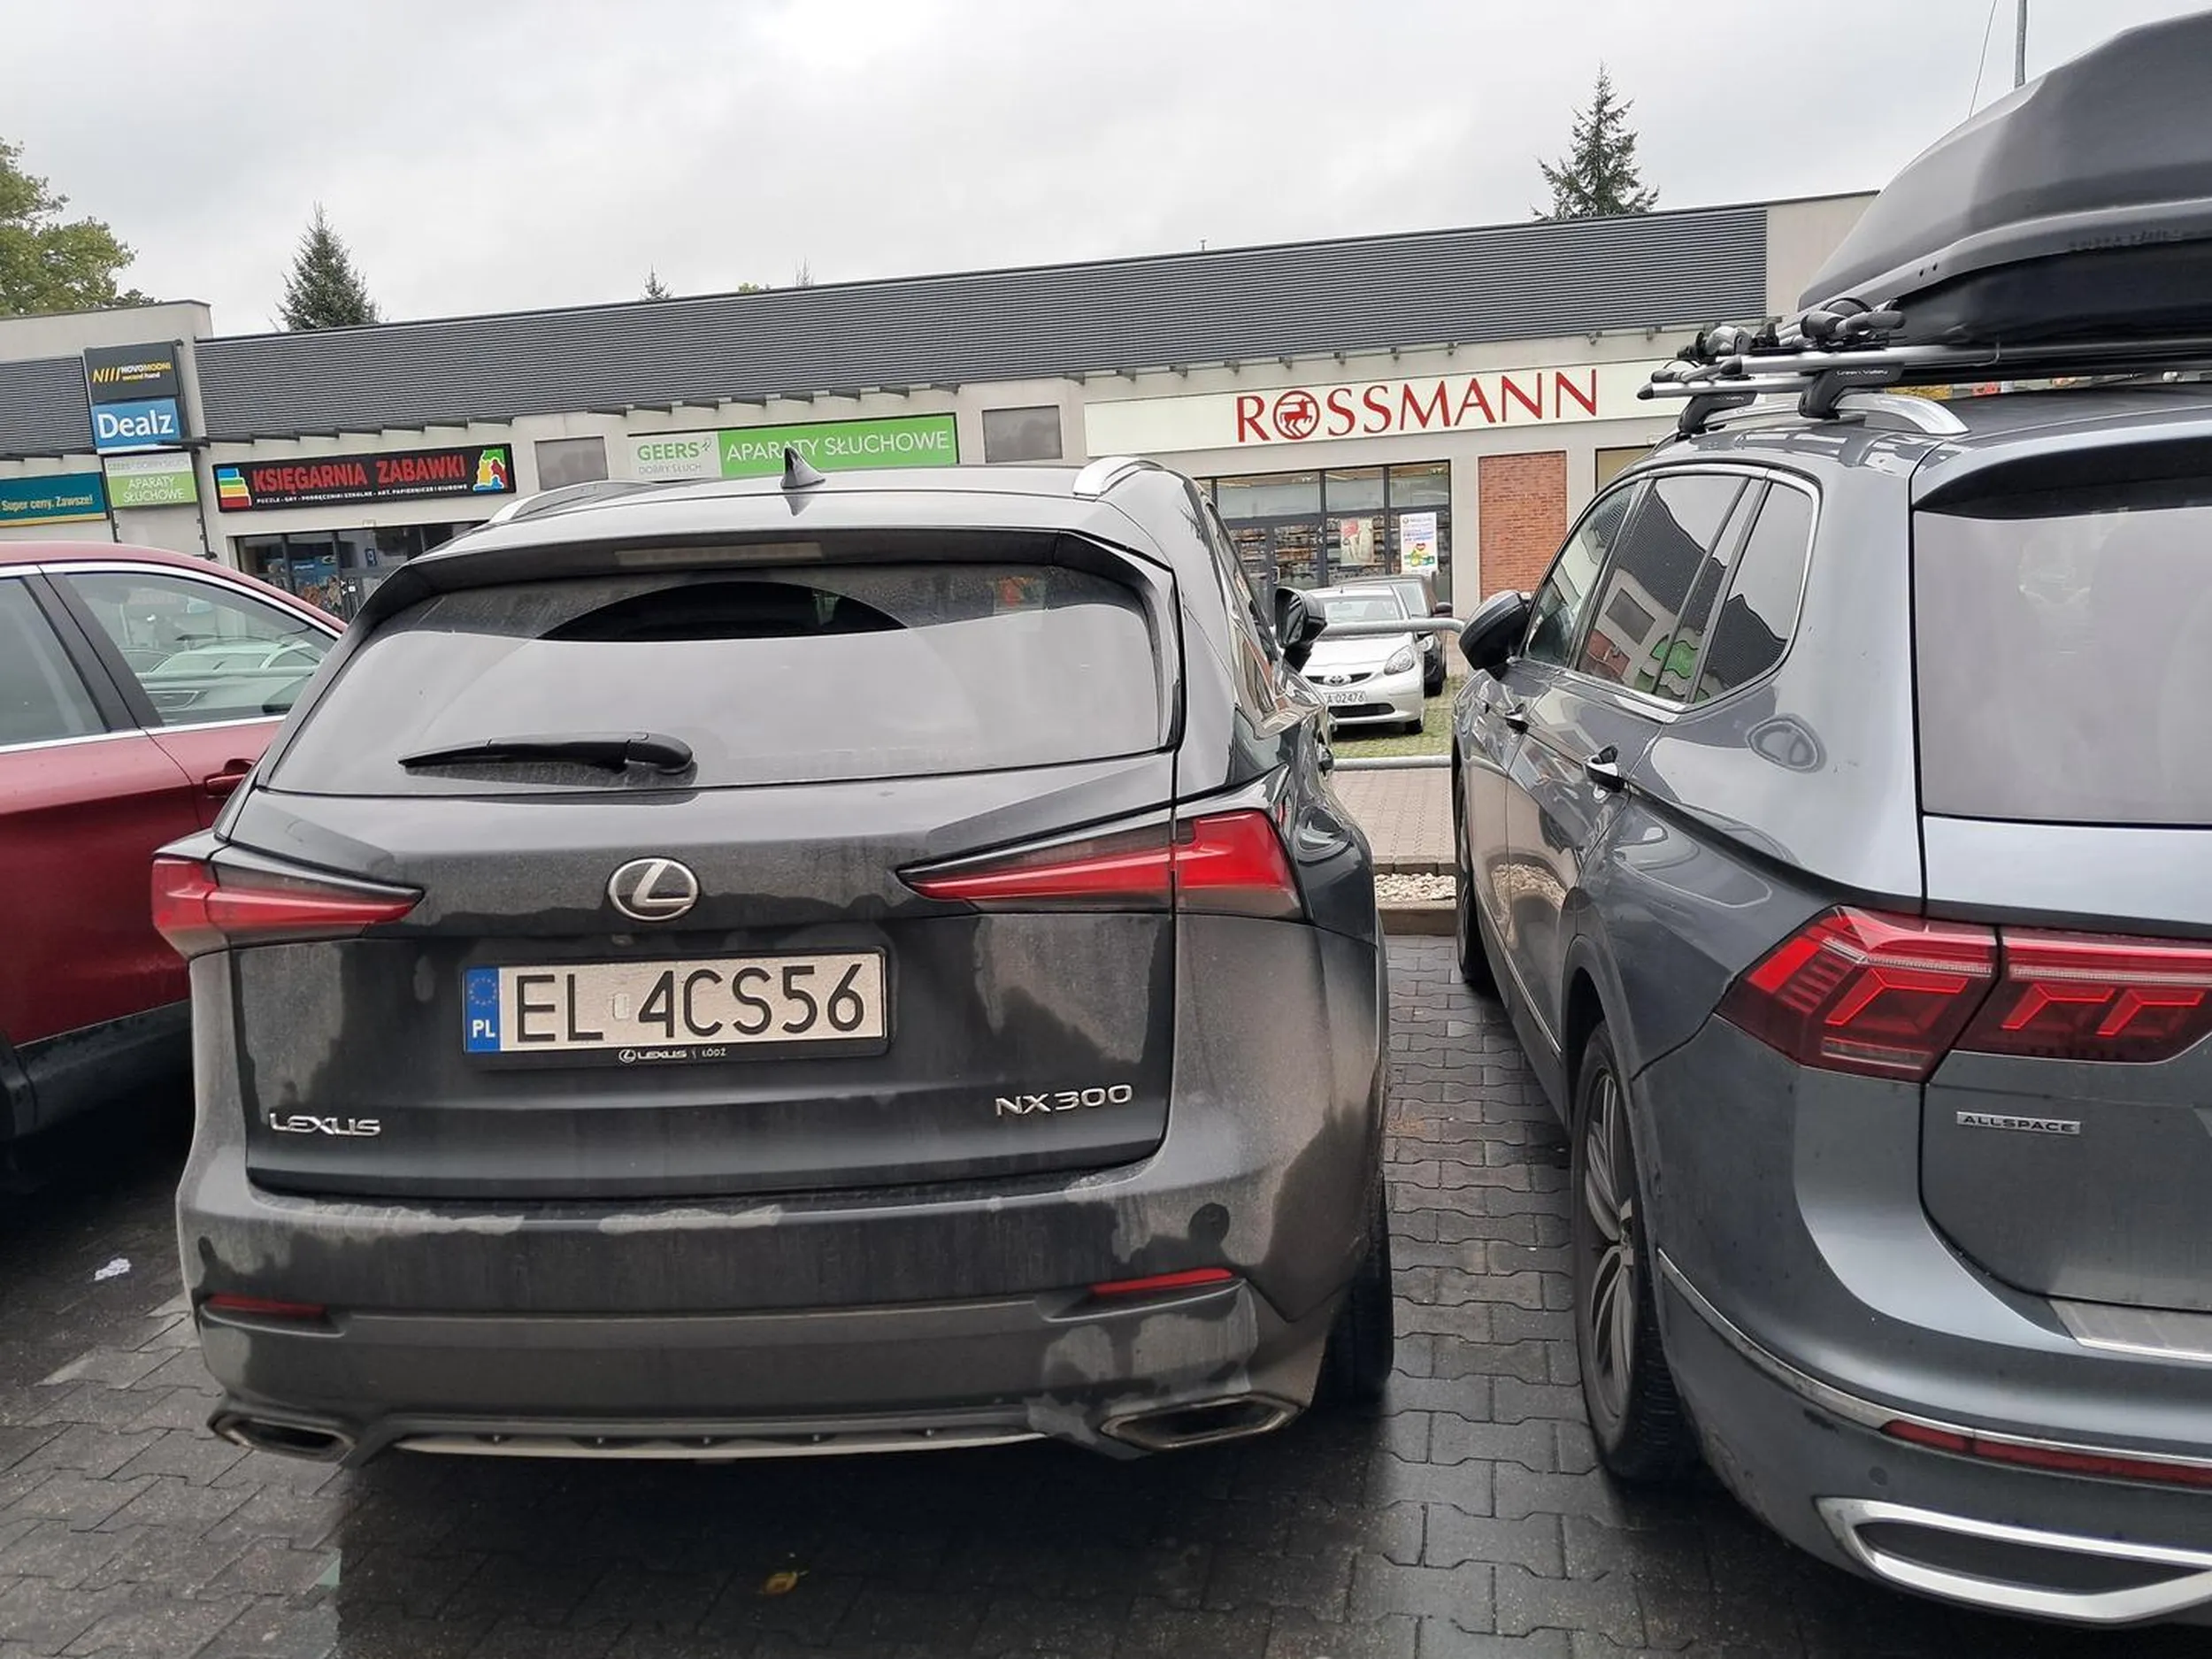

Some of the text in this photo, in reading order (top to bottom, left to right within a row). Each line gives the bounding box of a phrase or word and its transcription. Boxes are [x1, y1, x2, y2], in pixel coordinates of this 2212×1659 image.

[1237, 368, 1597, 442] ROSSMANN
[97, 409, 174, 439] Dealz
[638, 442, 700, 461] GEERS
[825, 430, 950, 457] SŁUCHOWE
[127, 475, 174, 490] APARATY
[252, 454, 467, 495] KSIĘGARNIA ZABAWKI
[1, 499, 28, 511] Super
[55, 494, 93, 508] Zawsze!
[123, 488, 185, 503] SŁUCHOWE
[517, 963, 864, 1042] EL 4CS56
[472, 1019, 495, 1038] PL
[637, 1048, 687, 1059] LEXUS
[269, 1112, 381, 1136] LEXUS
[1962, 1115, 2077, 1133] ALLSPACE
